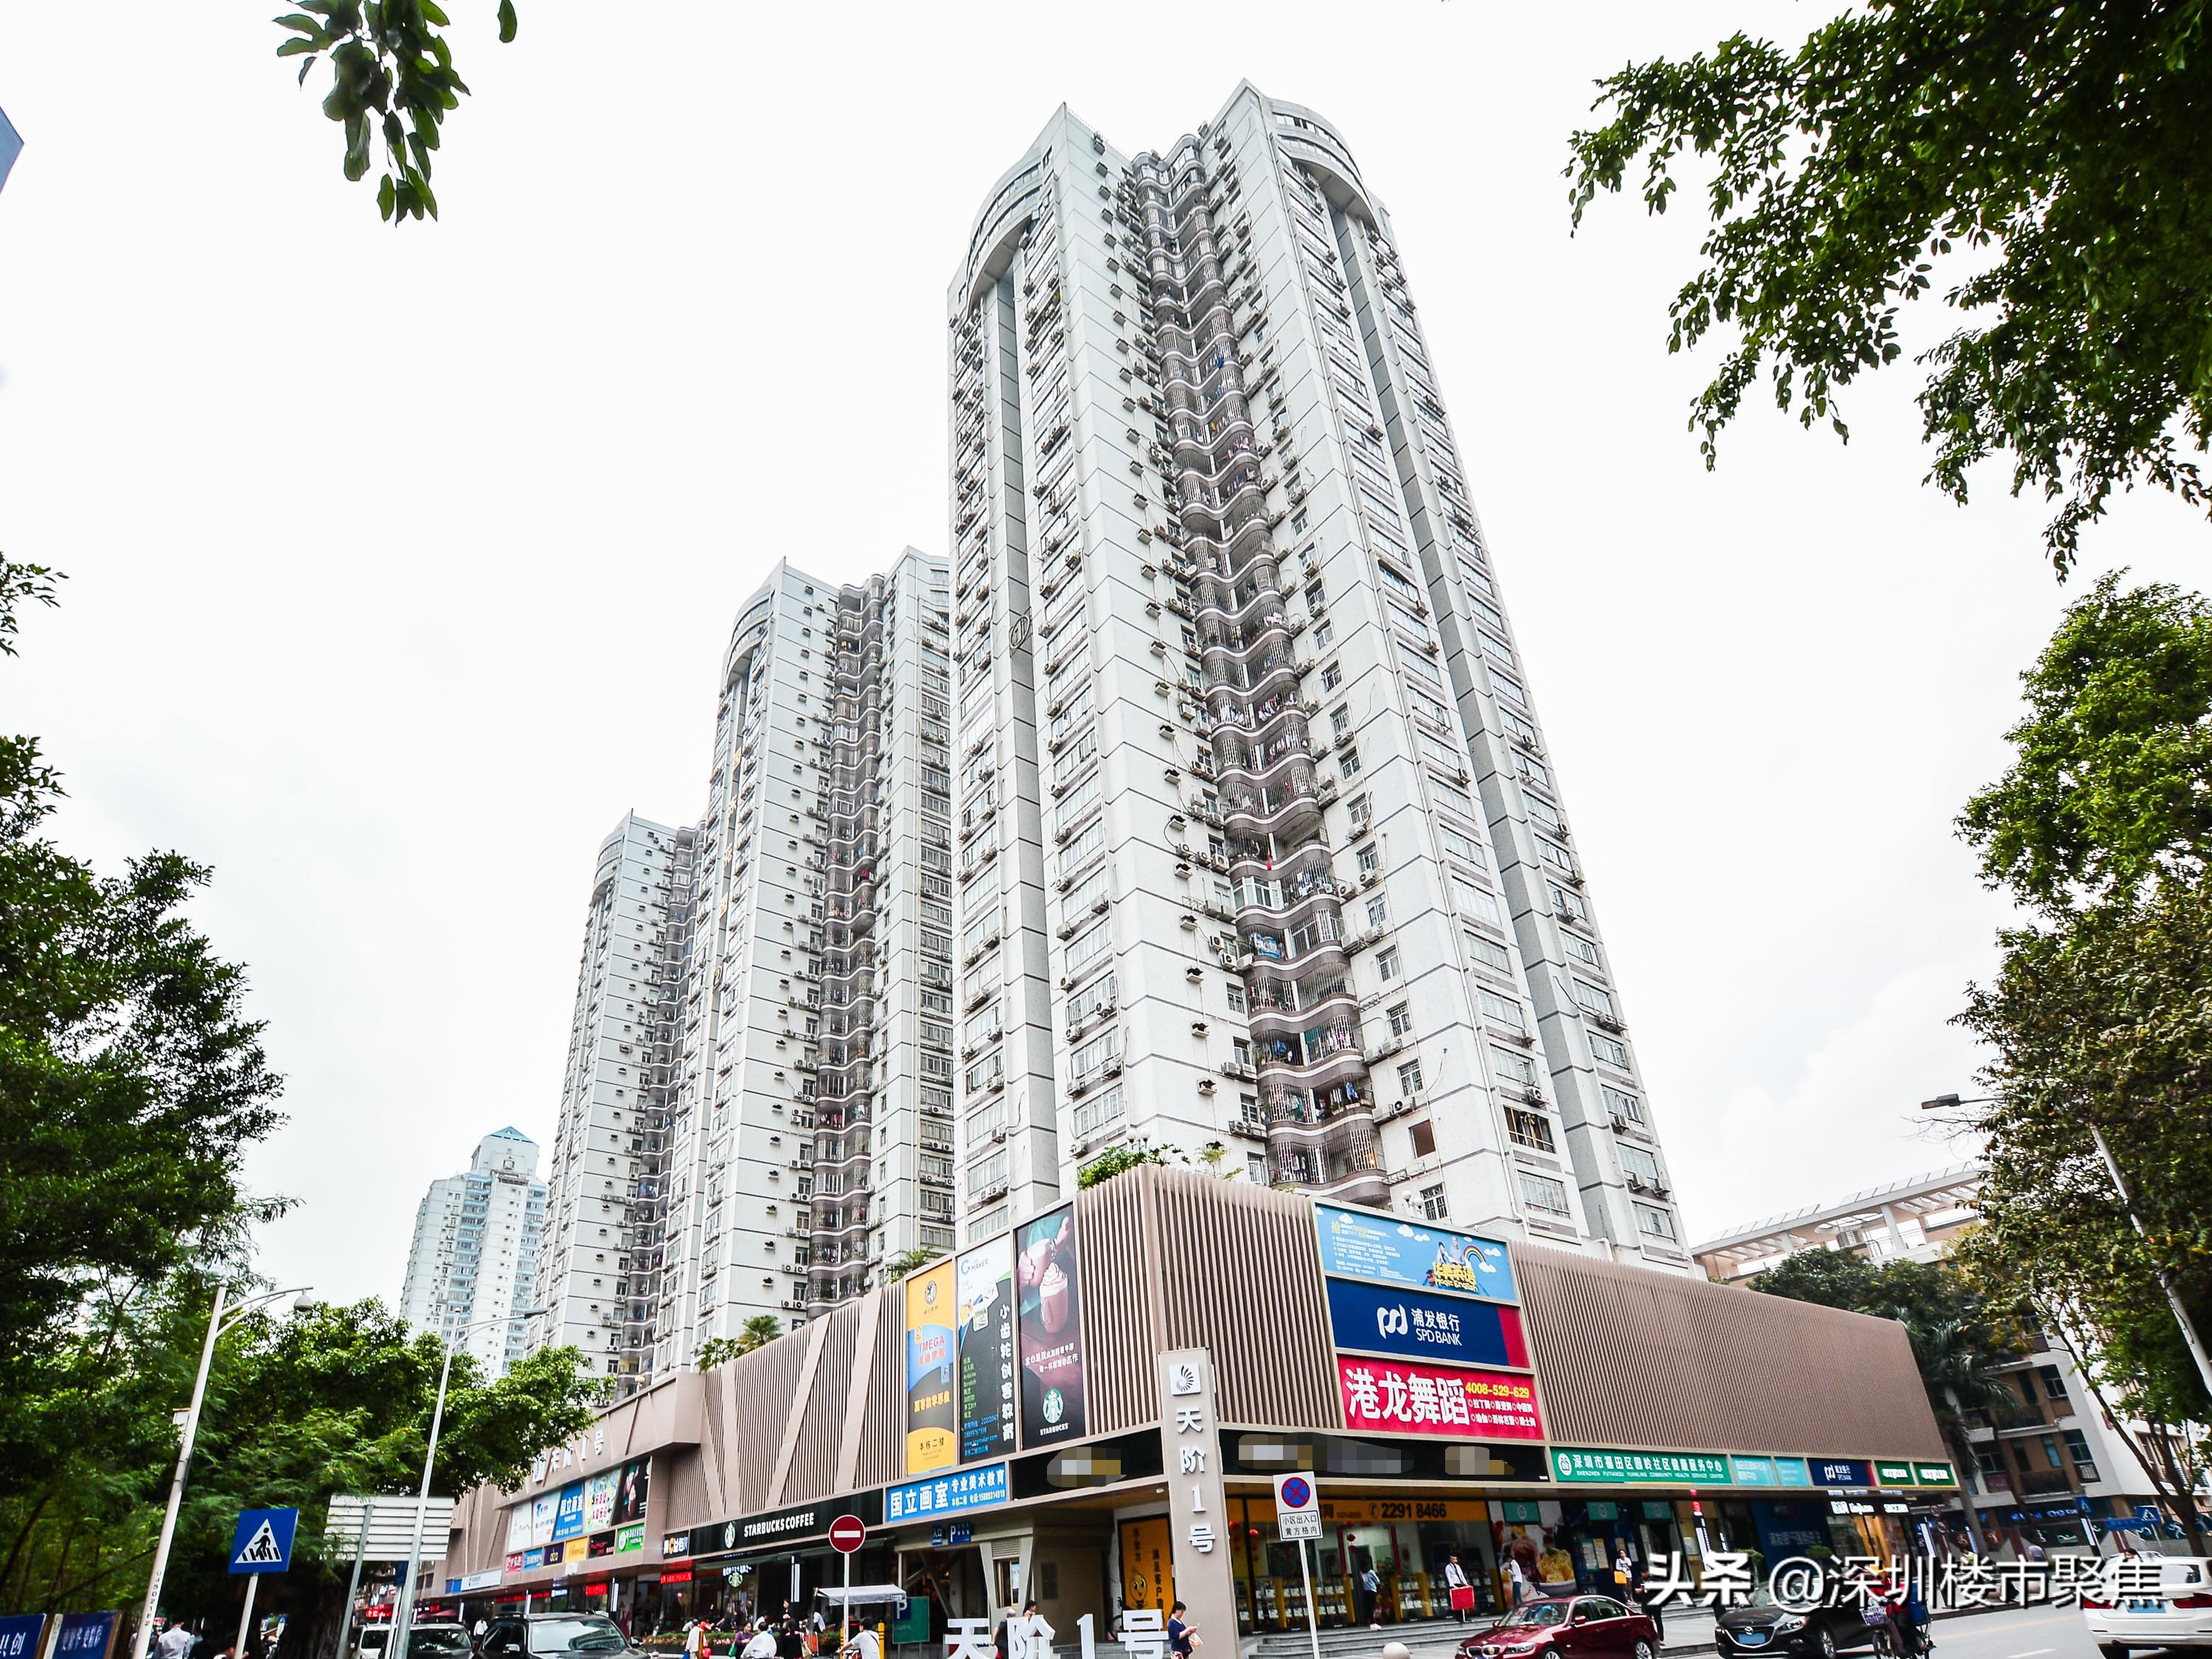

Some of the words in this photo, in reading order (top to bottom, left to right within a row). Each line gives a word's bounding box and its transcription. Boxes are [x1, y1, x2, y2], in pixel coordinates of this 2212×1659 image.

[1411, 1308, 1460, 1332] 浦发银行
[1416, 1328, 1435, 1342] SPD
[1435, 1331, 1462, 1346] BANK
[1346, 1368, 1470, 1425] 港龙舞蹈
[1465, 1382, 1529, 1399] 4008-529-629
[1040, 1423, 1070, 1436] STARBUCKS
[951, 1469, 1005, 1493] 专业美术教育
[1176, 1407, 1216, 1554] 天阶1号
[891, 1481, 948, 1519] 国立画室
[1382, 1504, 1412, 1518] 2291
[1416, 1503, 1447, 1518] 8466
[744, 1518, 785, 1538] STARBUCKS
[785, 1512, 814, 1529] COFFEE
[1283, 1514, 1317, 1525] 小区出入口
